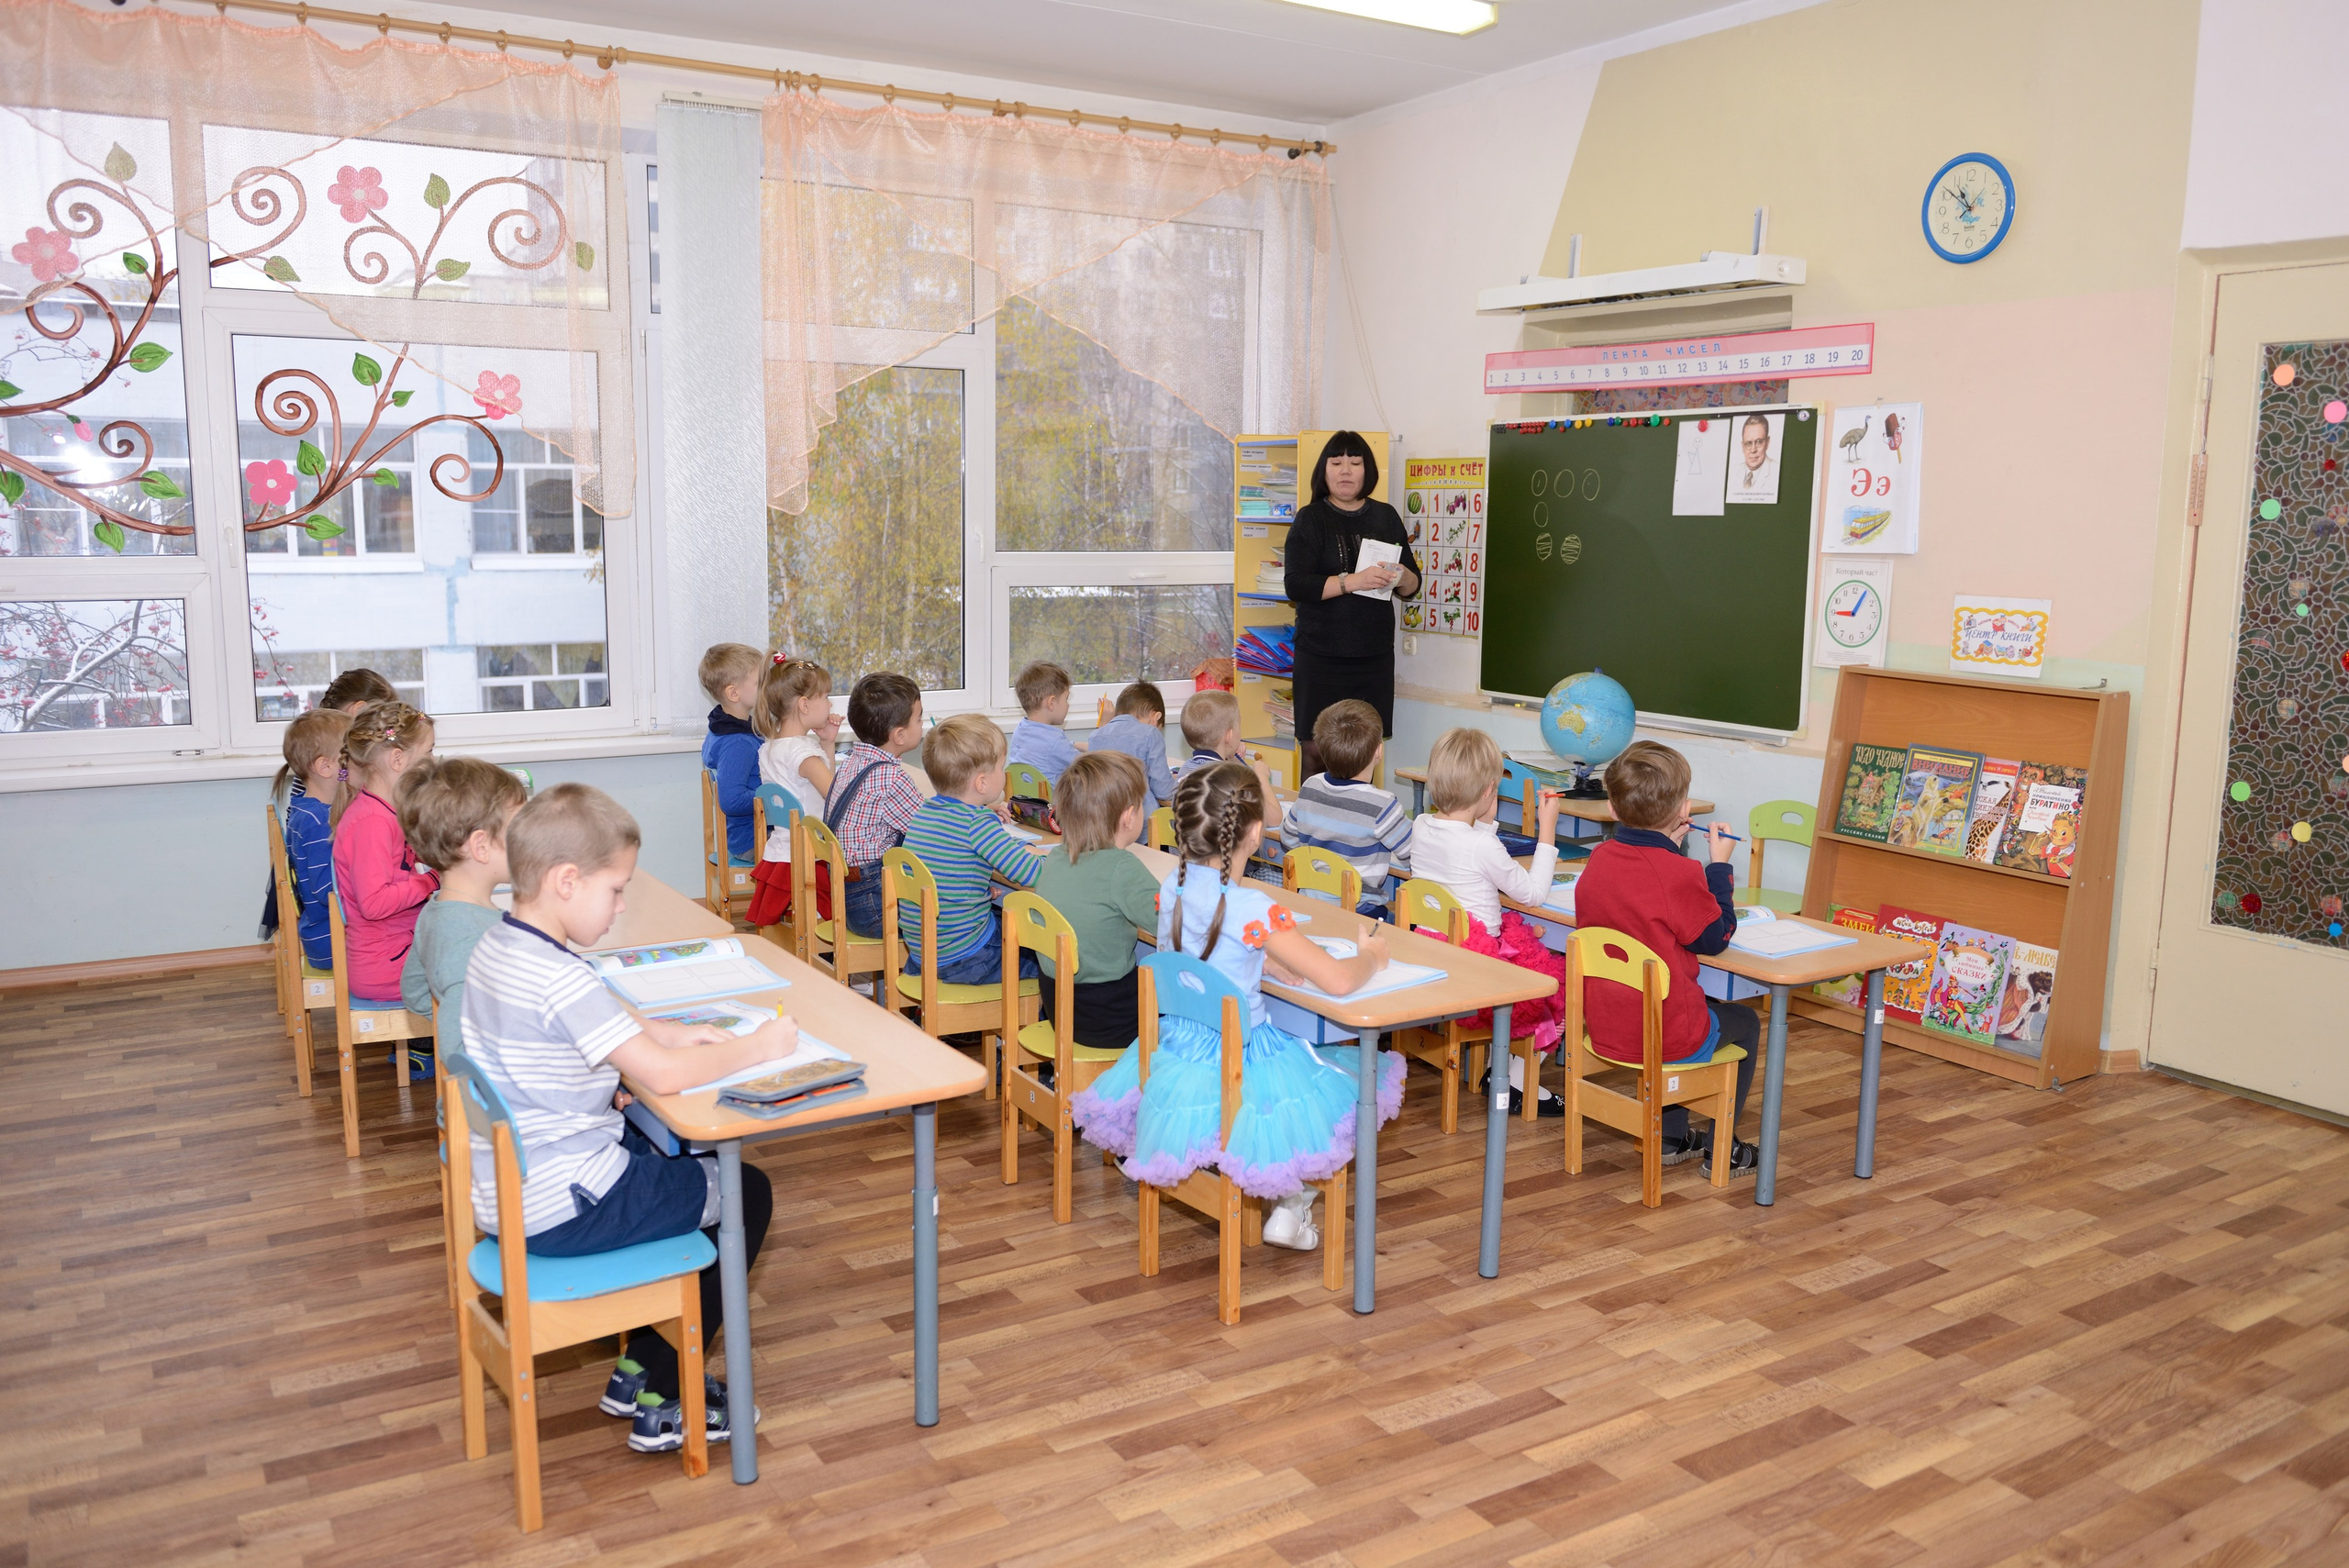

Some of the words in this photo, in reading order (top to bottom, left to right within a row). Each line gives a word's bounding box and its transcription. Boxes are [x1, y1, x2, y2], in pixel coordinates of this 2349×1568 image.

[1954, 174, 1961, 187] 11
[1966, 168, 1976, 182] 12
[1991, 182, 1999, 195] 2
[1939, 206, 1946, 217] 9
[1995, 199, 2003, 212] 3
[1942, 222, 1950, 234] 8
[1990, 217, 1998, 228] 4
[1953, 232, 1959, 245] 7
[1980, 229, 1987, 242] 5
[1965, 236, 1973, 249] 6
[1602, 350, 1648, 360] ЛЕНТА
[1665, 343, 1720, 356] ЧИСЕЛ
[1505, 373, 1508, 383] 2
[1521, 373, 1525, 381] 3
[1537, 372, 1542, 380] 4
[1554, 371, 1558, 380] 5
[1570, 370, 1575, 379] 6
[1587, 369, 1592, 378] 7
[1605, 368, 1609, 377] 8
[1623, 367, 1628, 376] 9
[1640, 366, 1648, 375] 10
[1658, 365, 1666, 374] 11
[1678, 363, 1687, 373] 12
[1698, 361, 1708, 372] 13
[1719, 361, 1728, 371] 14
[1739, 359, 1749, 369] 15
[1760, 357, 1770, 367] 16
[1782, 355, 1792, 365] 17
[1804, 353, 1815, 364] 18
[1828, 351, 1839, 362] 19
[1852, 350, 1863, 361] 20
[1409, 464, 1447, 477] ЦИФРЫ
[1460, 462, 1484, 476] СЧЁТ
[1433, 493, 1440, 513] 1
[1474, 493, 1482, 513] 6
[1431, 522, 1440, 541] 2
[1473, 524, 1480, 542] 7
[1431, 551, 1439, 571] 3
[1470, 552, 1478, 573] 8
[1836, 568, 1864, 577] Который
[1429, 580, 1438, 599] 4
[1470, 582, 1477, 602] 9
[1430, 608, 1437, 628] 5
[1466, 611, 1479, 631] 10
[1855, 746, 1875, 765] ЧУДО
[1876, 749, 1906, 772] ЧУДНОЕ
[1911, 758, 1972, 779] ВНИМАНИЕ
[2030, 798, 2070, 811] БУРАТИНО
[2032, 794, 2072, 803] ПРИКЛЮЧЕНИЯ
[1865, 832, 1886, 840] СКАЗКИ
[1951, 965, 1987, 980] СКАЗКИ
[315, 985, 320, 994] 2
[363, 1021, 370, 1030] 3
[1672, 1080, 1675, 1089] 2
[1502, 1096, 1507, 1106] 2
